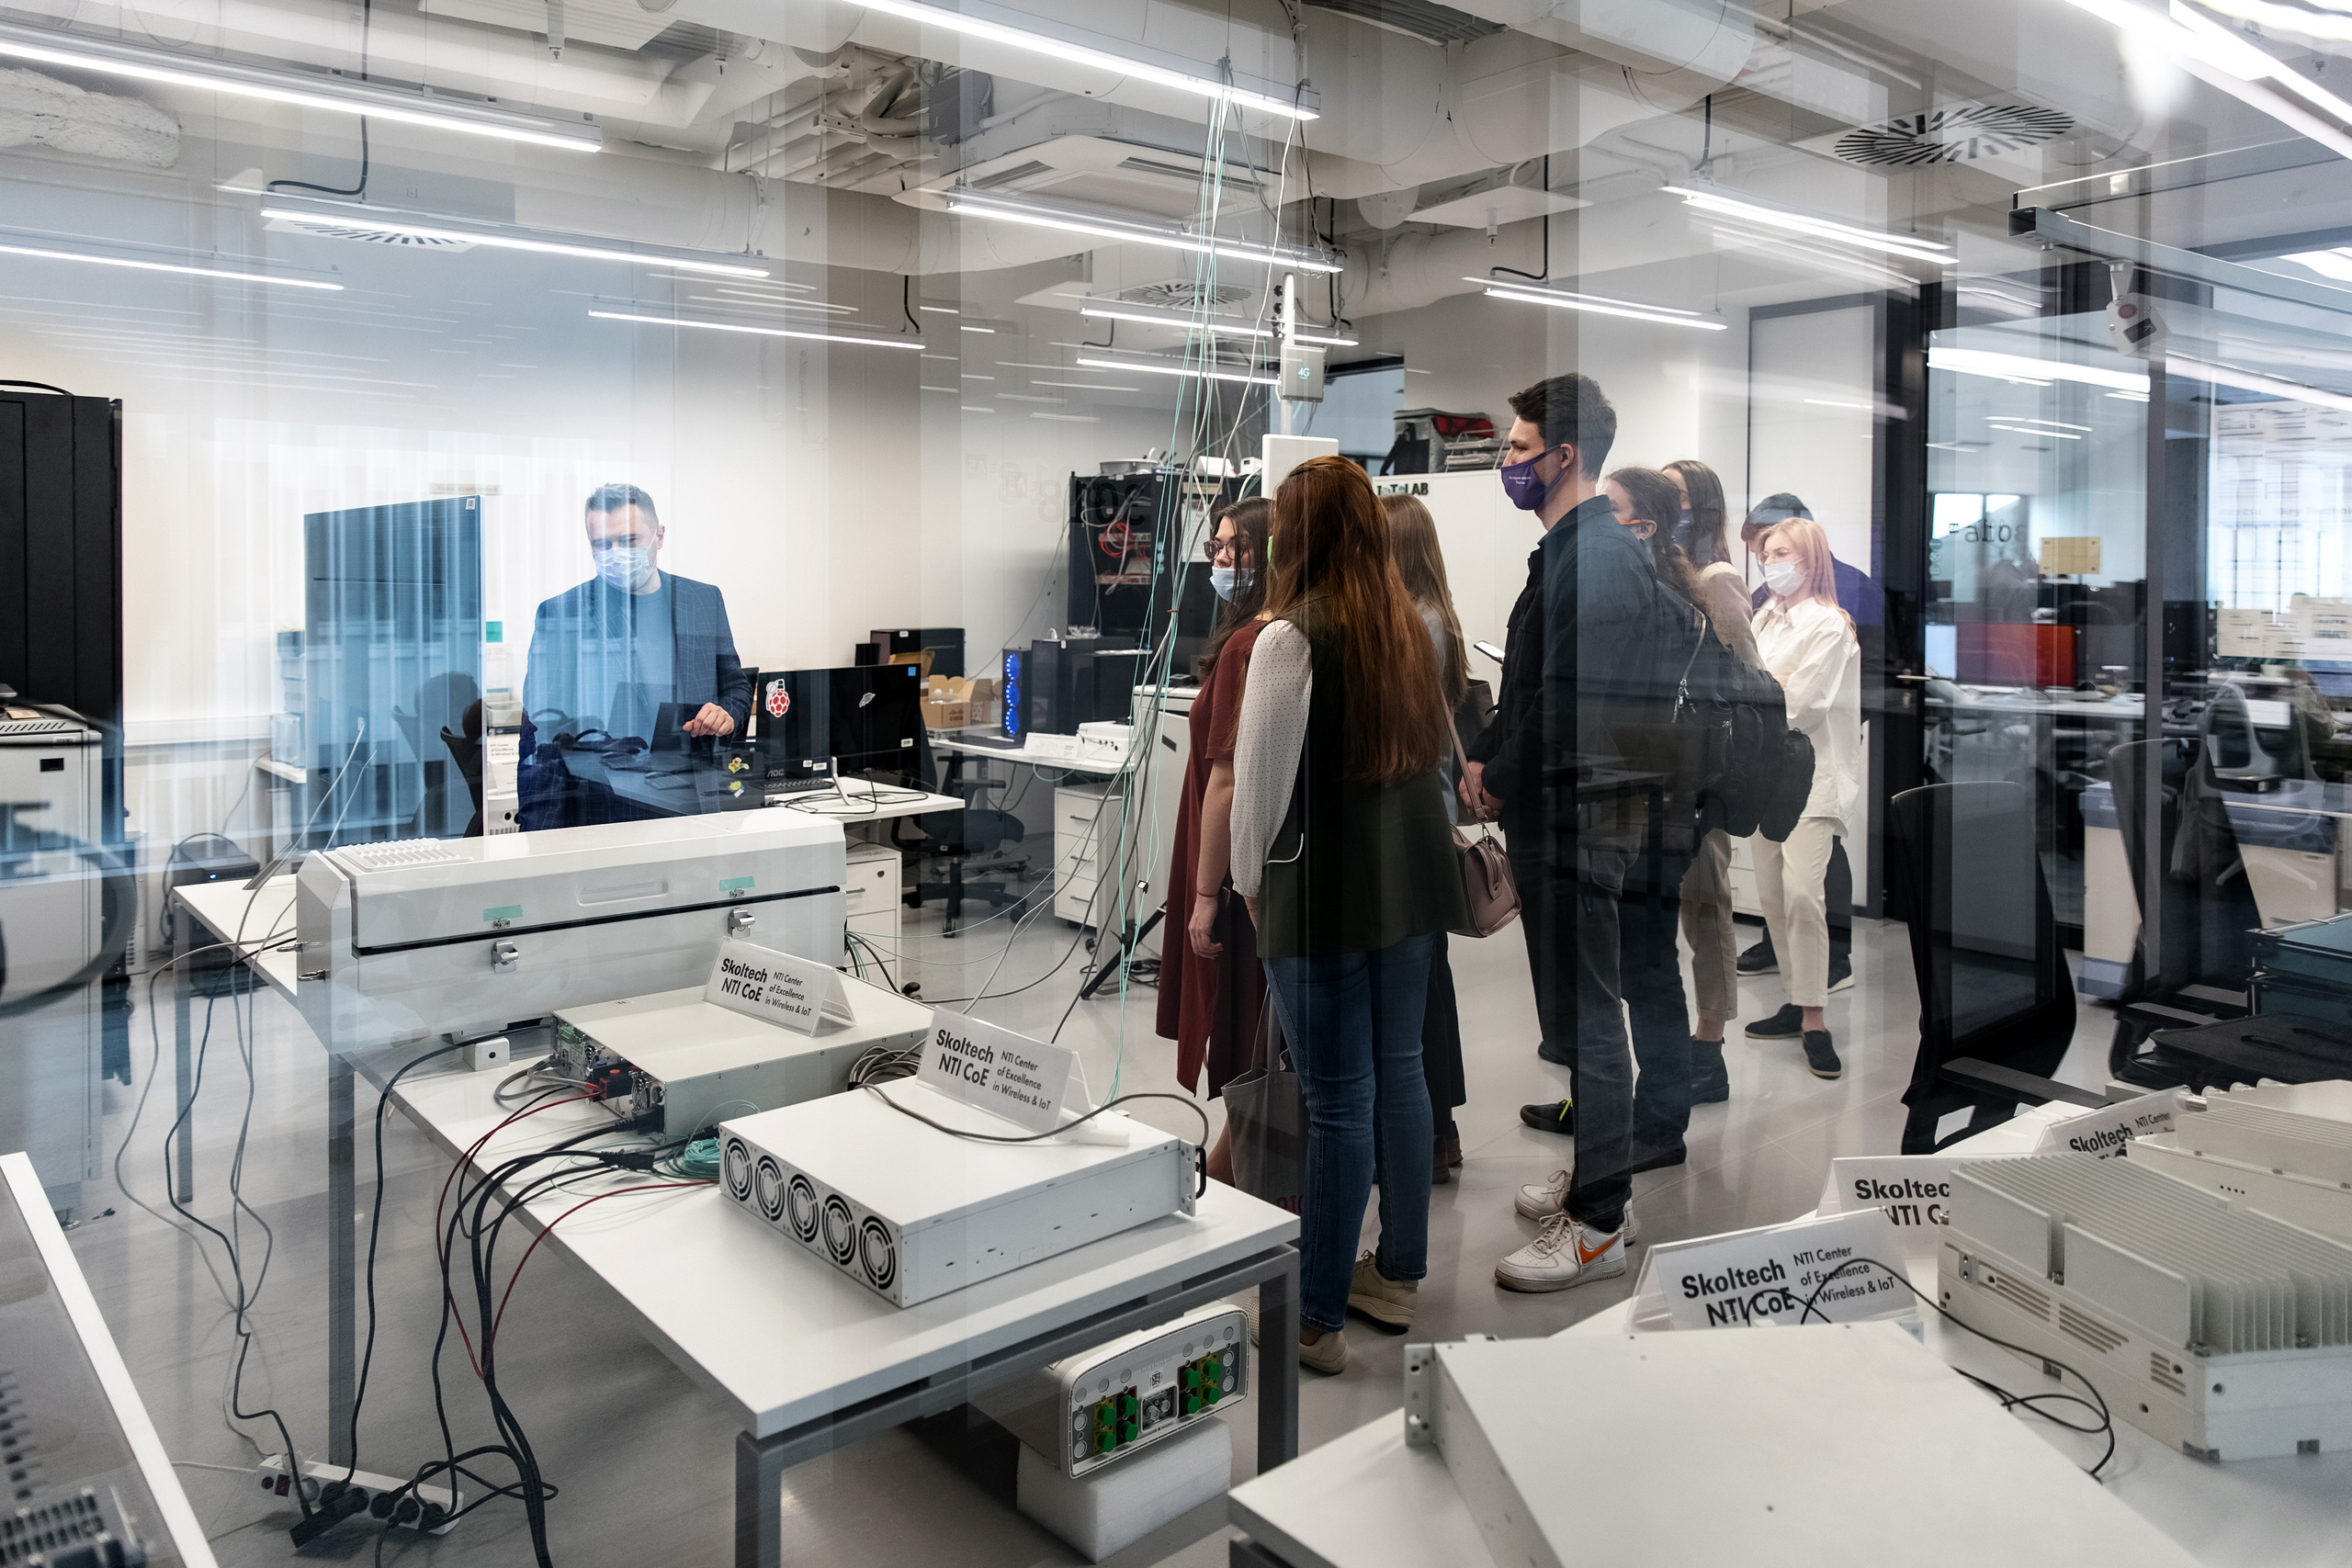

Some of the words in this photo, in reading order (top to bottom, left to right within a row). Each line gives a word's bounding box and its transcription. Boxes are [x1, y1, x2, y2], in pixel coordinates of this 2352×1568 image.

[1298, 367, 1310, 377] 4G
[767, 769, 785, 777] AOC
[721, 958, 768, 983] Skoltech
[773, 972, 784, 981] NTI
[784, 974, 803, 986] Center
[721, 977, 741, 995] NTI
[741, 983, 763, 1001] CoE
[776, 986, 804, 1000] Excellence
[764, 997, 771, 1005] in
[772, 998, 795, 1012] Wireless
[796, 1005, 800, 1013] &
[801, 1007, 811, 1016] IoT
[936, 1029, 994, 1064] Skoltech
[938, 1053, 962, 1077] NTI
[963, 1062, 989, 1087] CoE
[1001, 1051, 1014, 1064] NTI
[1014, 1055, 1038, 1071] Center
[997, 1066, 1006, 1077] of
[1005, 1069, 1042, 1089] Excellence
[992, 1081, 1000, 1091] in
[1001, 1084, 1030, 1103] Wireless
[1031, 1096, 1037, 1106] &
[1038, 1098, 1051, 1111] IoT
[2135, 1116, 2149, 1129] NTI
[2069, 1122, 2133, 1153] Skoltech
[1854, 1179, 1950, 1200] Skoltec
[1793, 1251, 1815, 1267] NTI
[1816, 1247, 1852, 1262] Center
[1681, 1258, 1786, 1299] Skoltech
[1800, 1270, 1812, 1287] of
[1814, 1263, 1871, 1284] Excellence
[1818, 1285, 1866, 1305] Wireless
[1867, 1280, 1877, 1293] &
[1877, 1276, 1895, 1292] IoT
[1705, 1296, 1747, 1327] NTI
[1750, 1286, 1795, 1316] CoE
